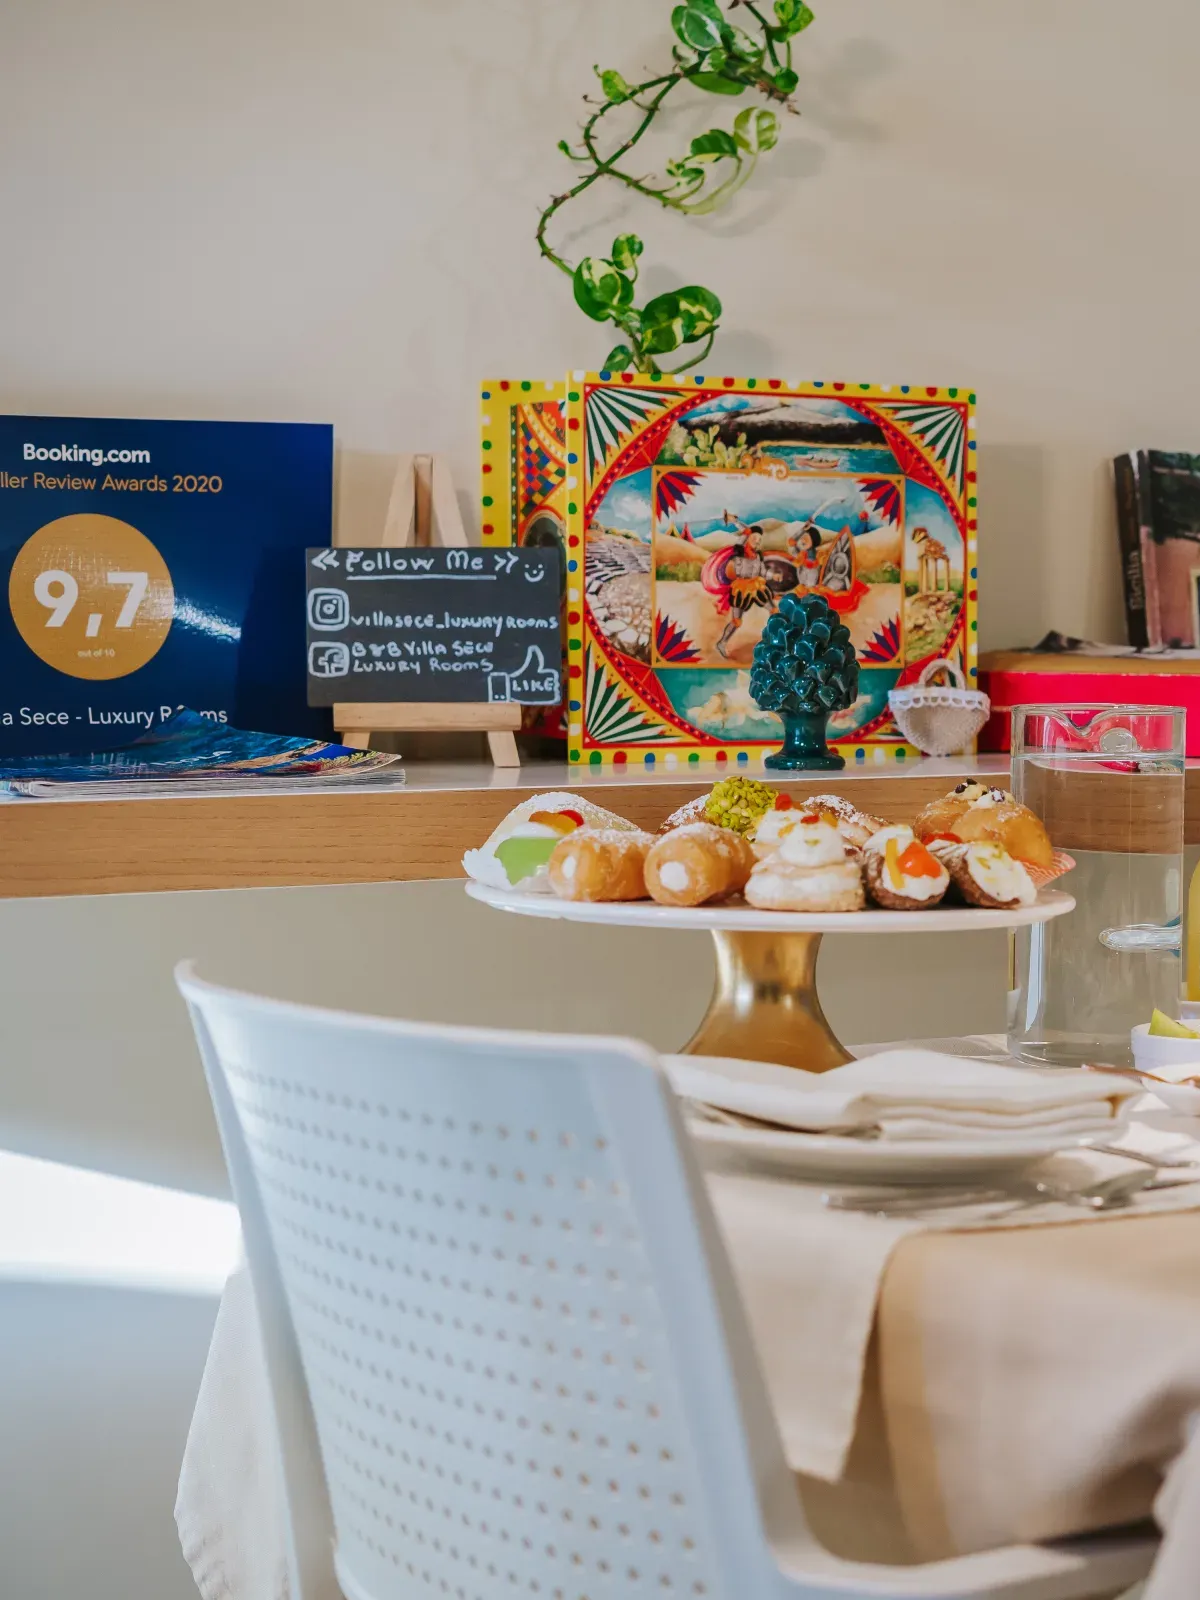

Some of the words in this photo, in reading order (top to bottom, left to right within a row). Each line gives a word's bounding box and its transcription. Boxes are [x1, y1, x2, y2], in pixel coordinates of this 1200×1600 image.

[23, 443, 150, 466] Booking.com
[33, 472, 97, 491] Review
[101, 474, 168, 492] Awards
[172, 475, 223, 493] 2020
[346, 551, 435, 572] Follow
[446, 550, 483, 571] Me
[34, 569, 149, 637] 9,7
[512, 680, 555, 692] LIKE
[20, 707, 69, 725] Sece
[88, 707, 154, 728] Luxury
[160, 704, 228, 723] Rms
